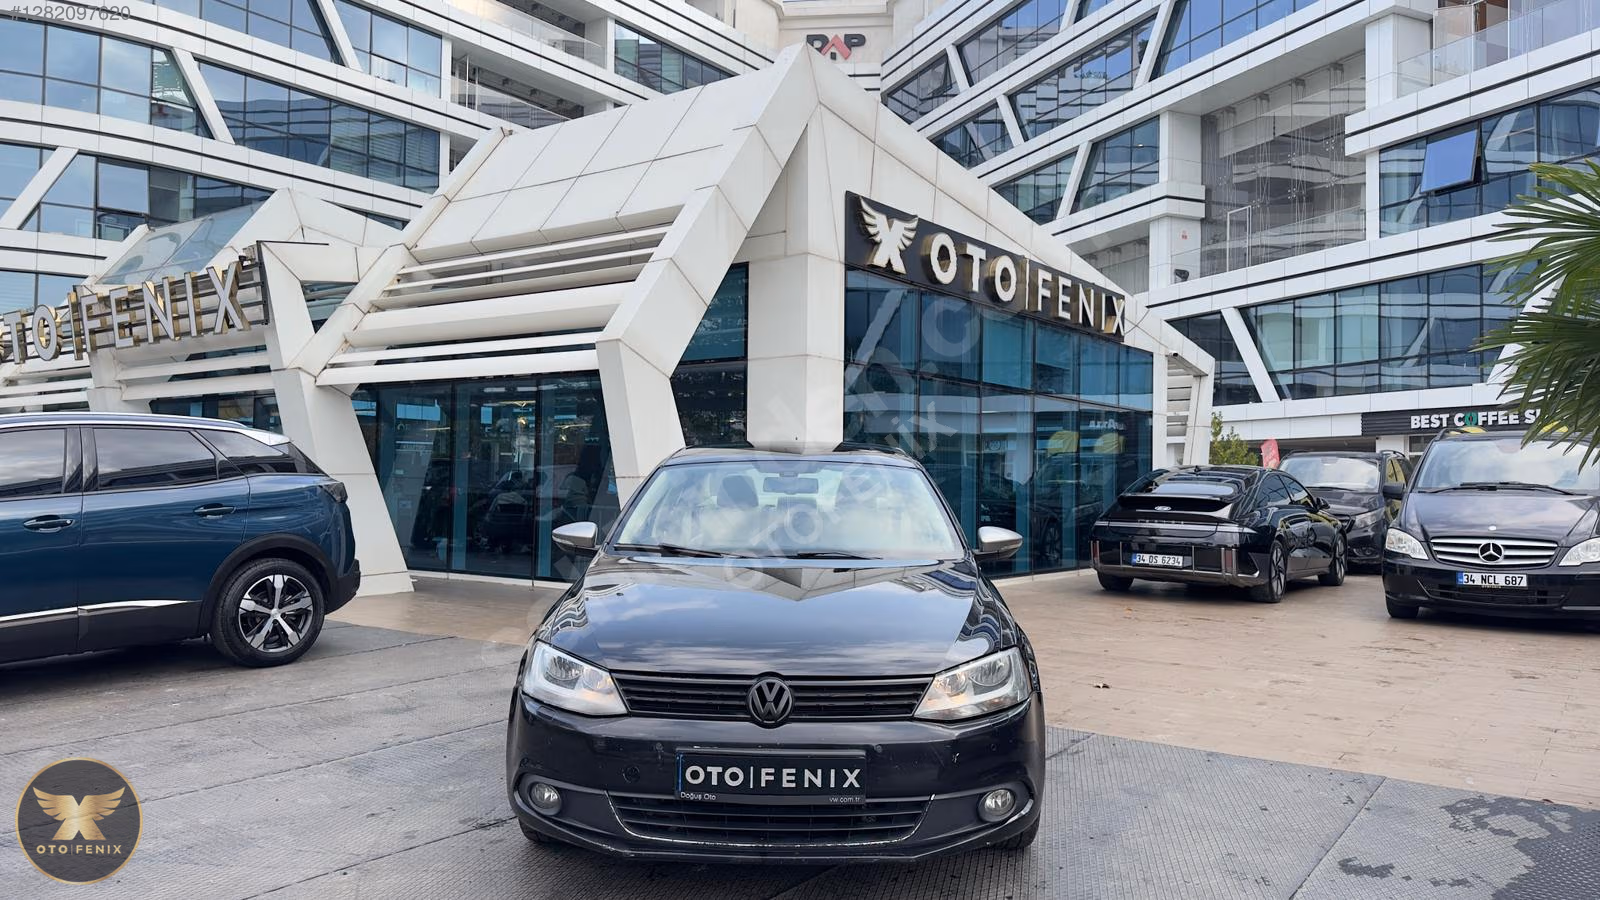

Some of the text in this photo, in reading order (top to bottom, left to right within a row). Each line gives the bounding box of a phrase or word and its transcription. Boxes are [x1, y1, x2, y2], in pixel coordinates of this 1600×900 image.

[924, 232, 1126, 336] OTO FENIX
[80, 261, 251, 353] FENIX
[1410, 413, 1450, 429] BEST
[1453, 410, 1520, 427] COFFEE
[1136, 554, 1146, 563] 34
[1161, 556, 1181, 565] 6234
[1463, 574, 1524, 586] 34 NCL 687
[684, 765, 861, 788] OTO FENIX
[703, 793, 717, 801] Oto
